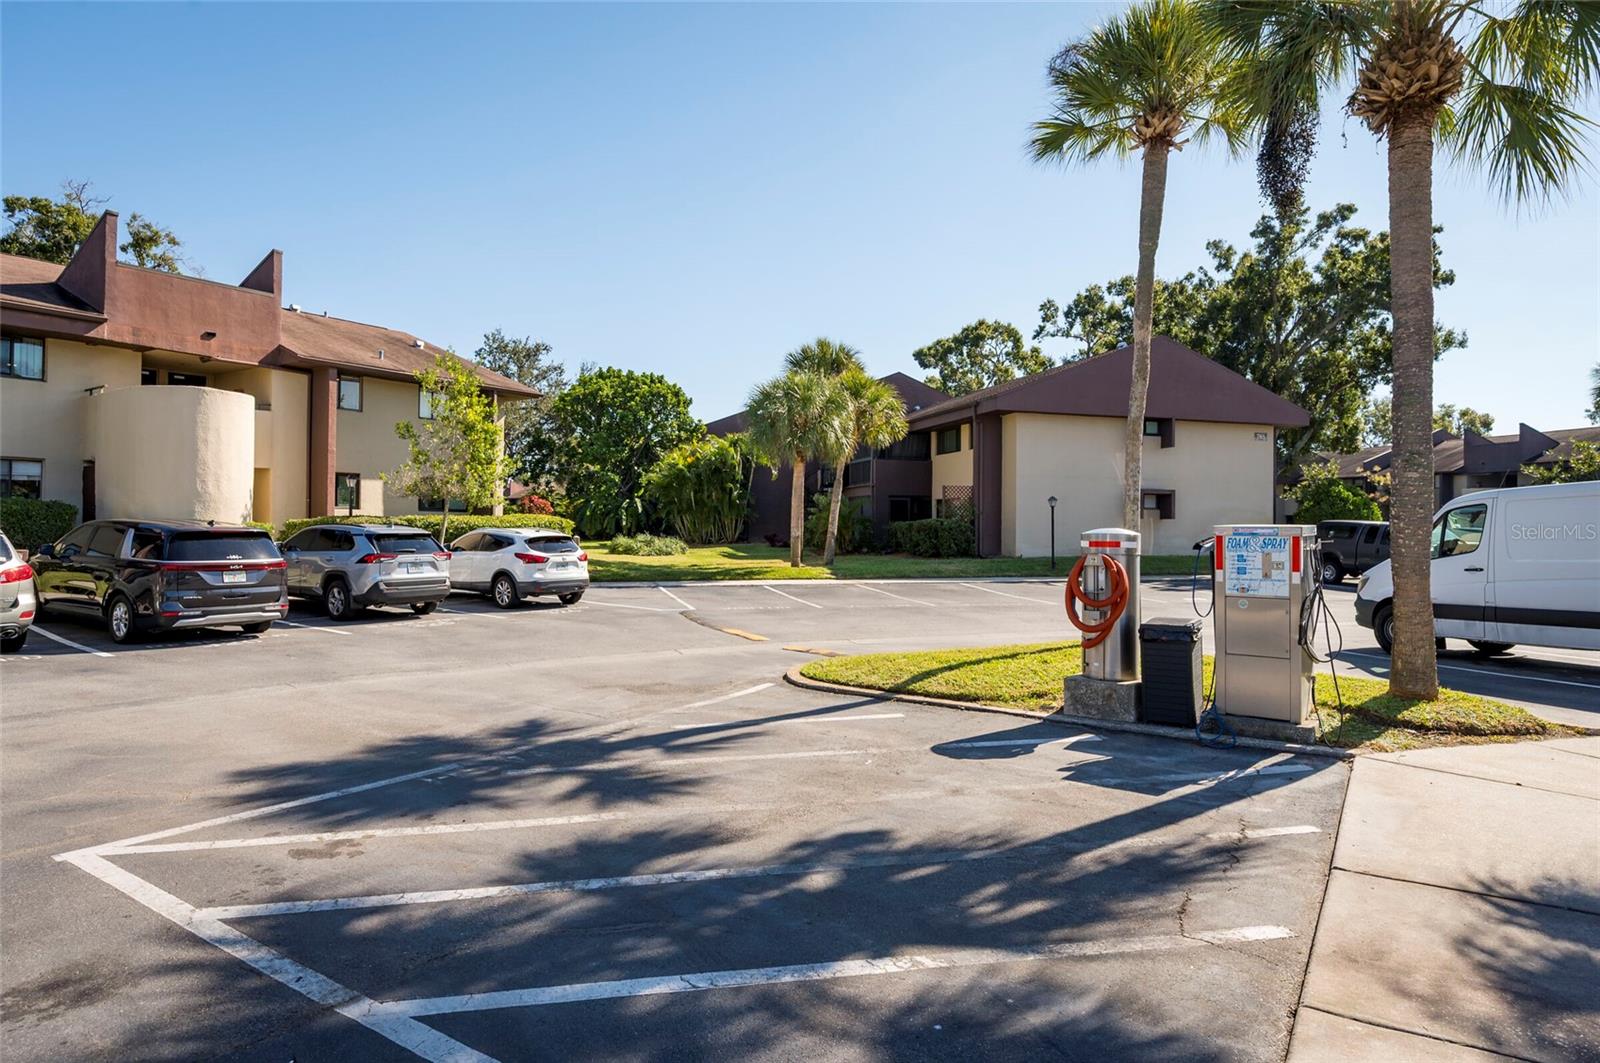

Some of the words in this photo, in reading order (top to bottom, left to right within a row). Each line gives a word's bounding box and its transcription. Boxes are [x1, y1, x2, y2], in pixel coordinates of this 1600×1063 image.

[1227, 538, 1249, 549] FOAM
[1247, 536, 1262, 553] &
[1262, 538, 1288, 549] SPRAY
